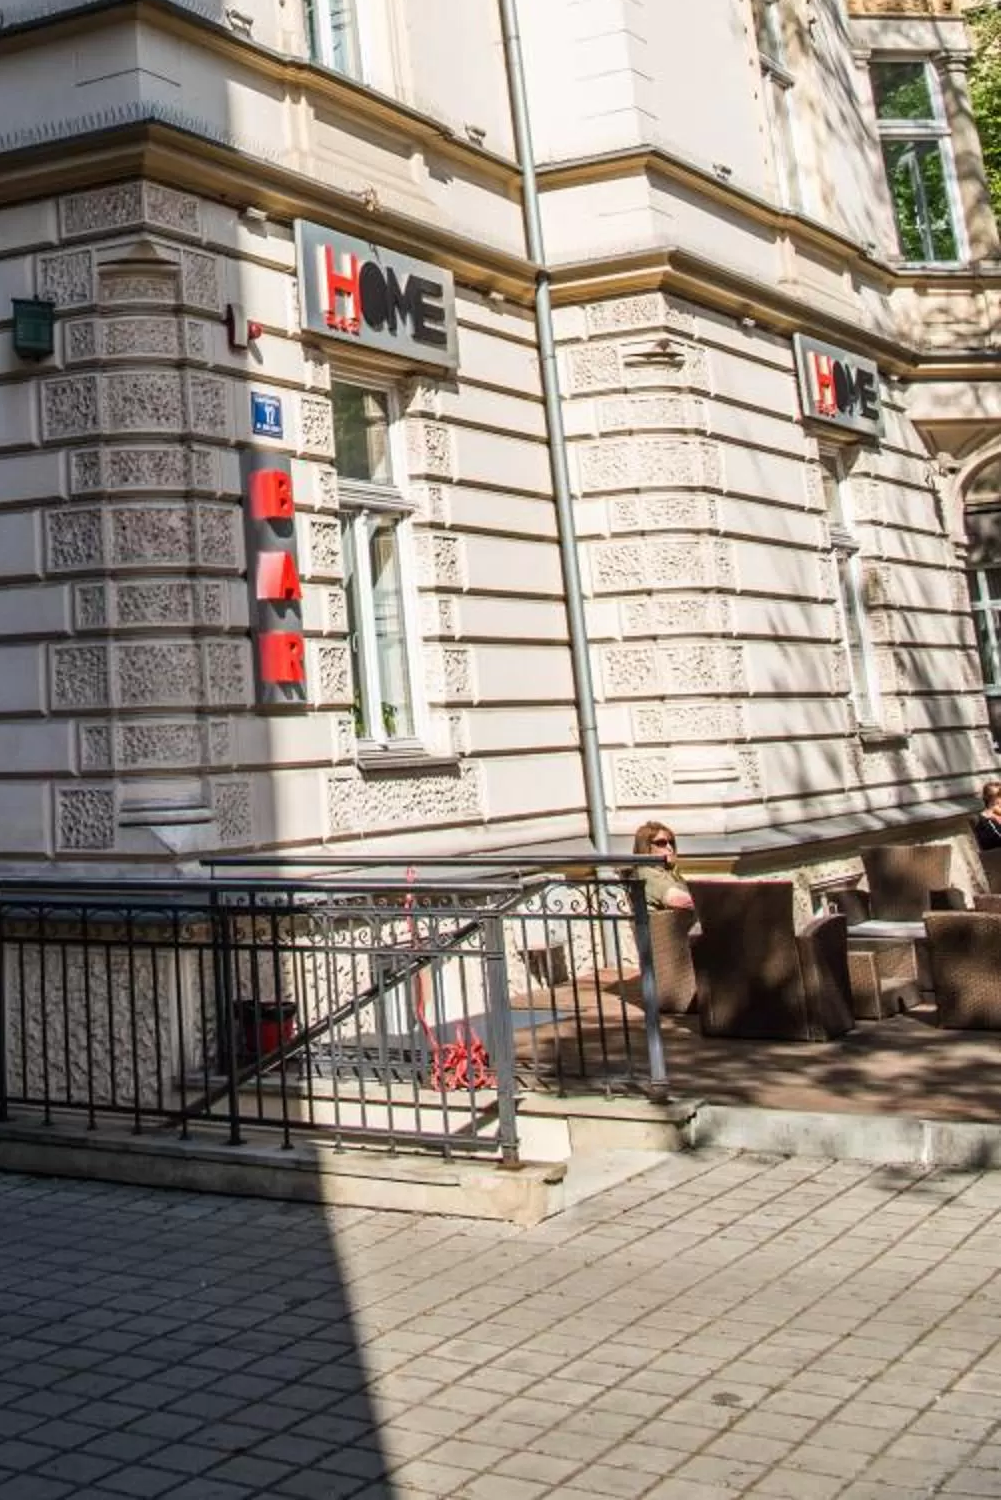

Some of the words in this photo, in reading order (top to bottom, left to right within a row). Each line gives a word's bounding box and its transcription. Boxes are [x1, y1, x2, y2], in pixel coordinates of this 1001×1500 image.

[317, 243, 448, 348] HOME
[807, 352, 880, 421] HOME
[252, 470, 305, 684] BAR
